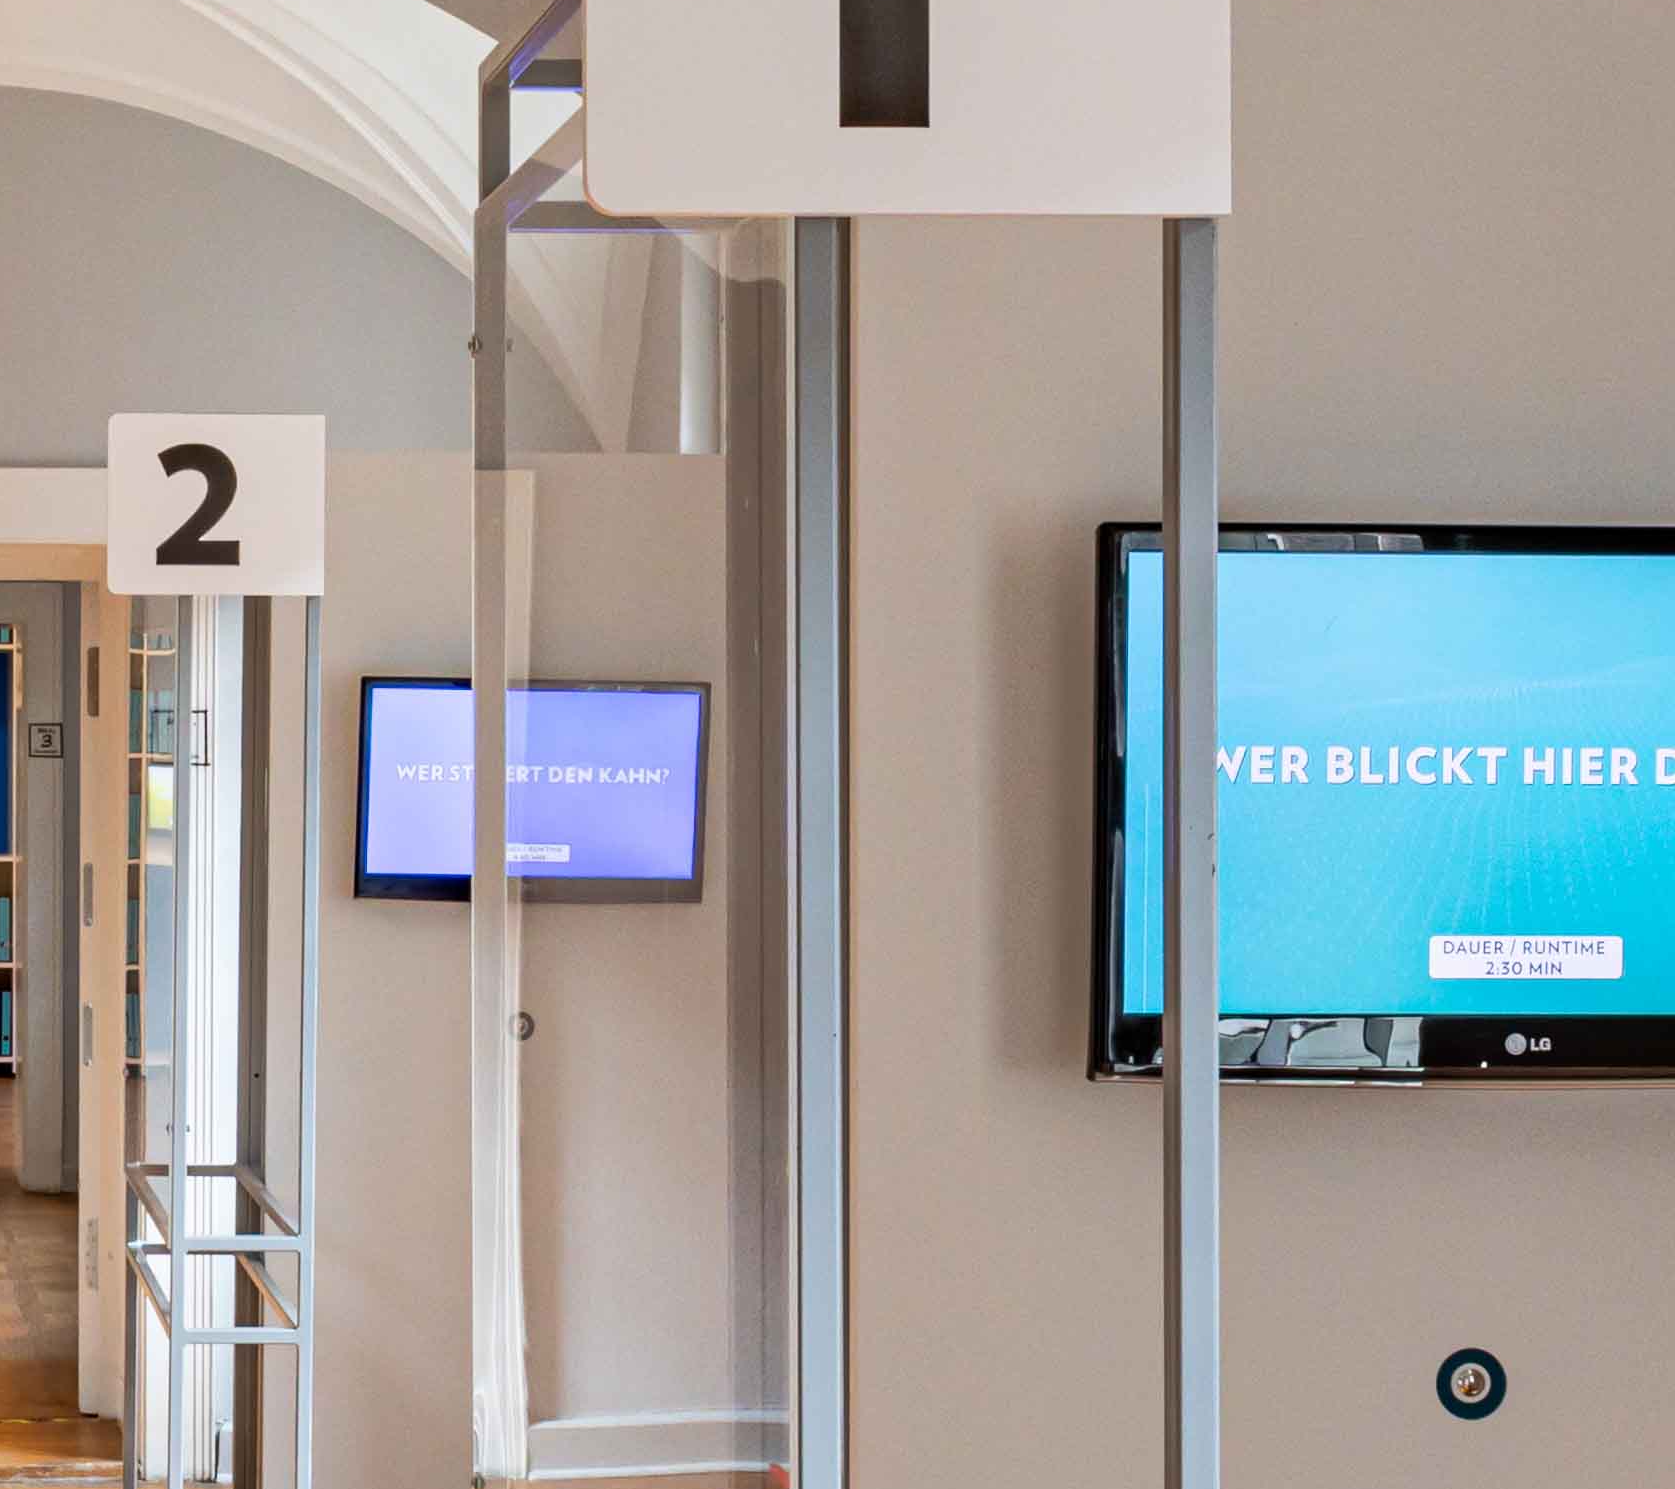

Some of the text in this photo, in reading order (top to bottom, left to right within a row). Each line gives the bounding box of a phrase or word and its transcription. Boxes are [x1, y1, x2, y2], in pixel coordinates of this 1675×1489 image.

[155, 443, 241, 567] 2
[41, 734, 53, 748] 3
[396, 764, 670, 785] WER STERT DEN KAHN?
[1326, 745, 1508, 785] BLICKT
[1522, 746, 1639, 785] HIER
[1442, 938, 1606, 957] DAUER / RUNTIME
[1484, 961, 1563, 977] 2:30 MIN
[1530, 1037, 1552, 1052] LG
